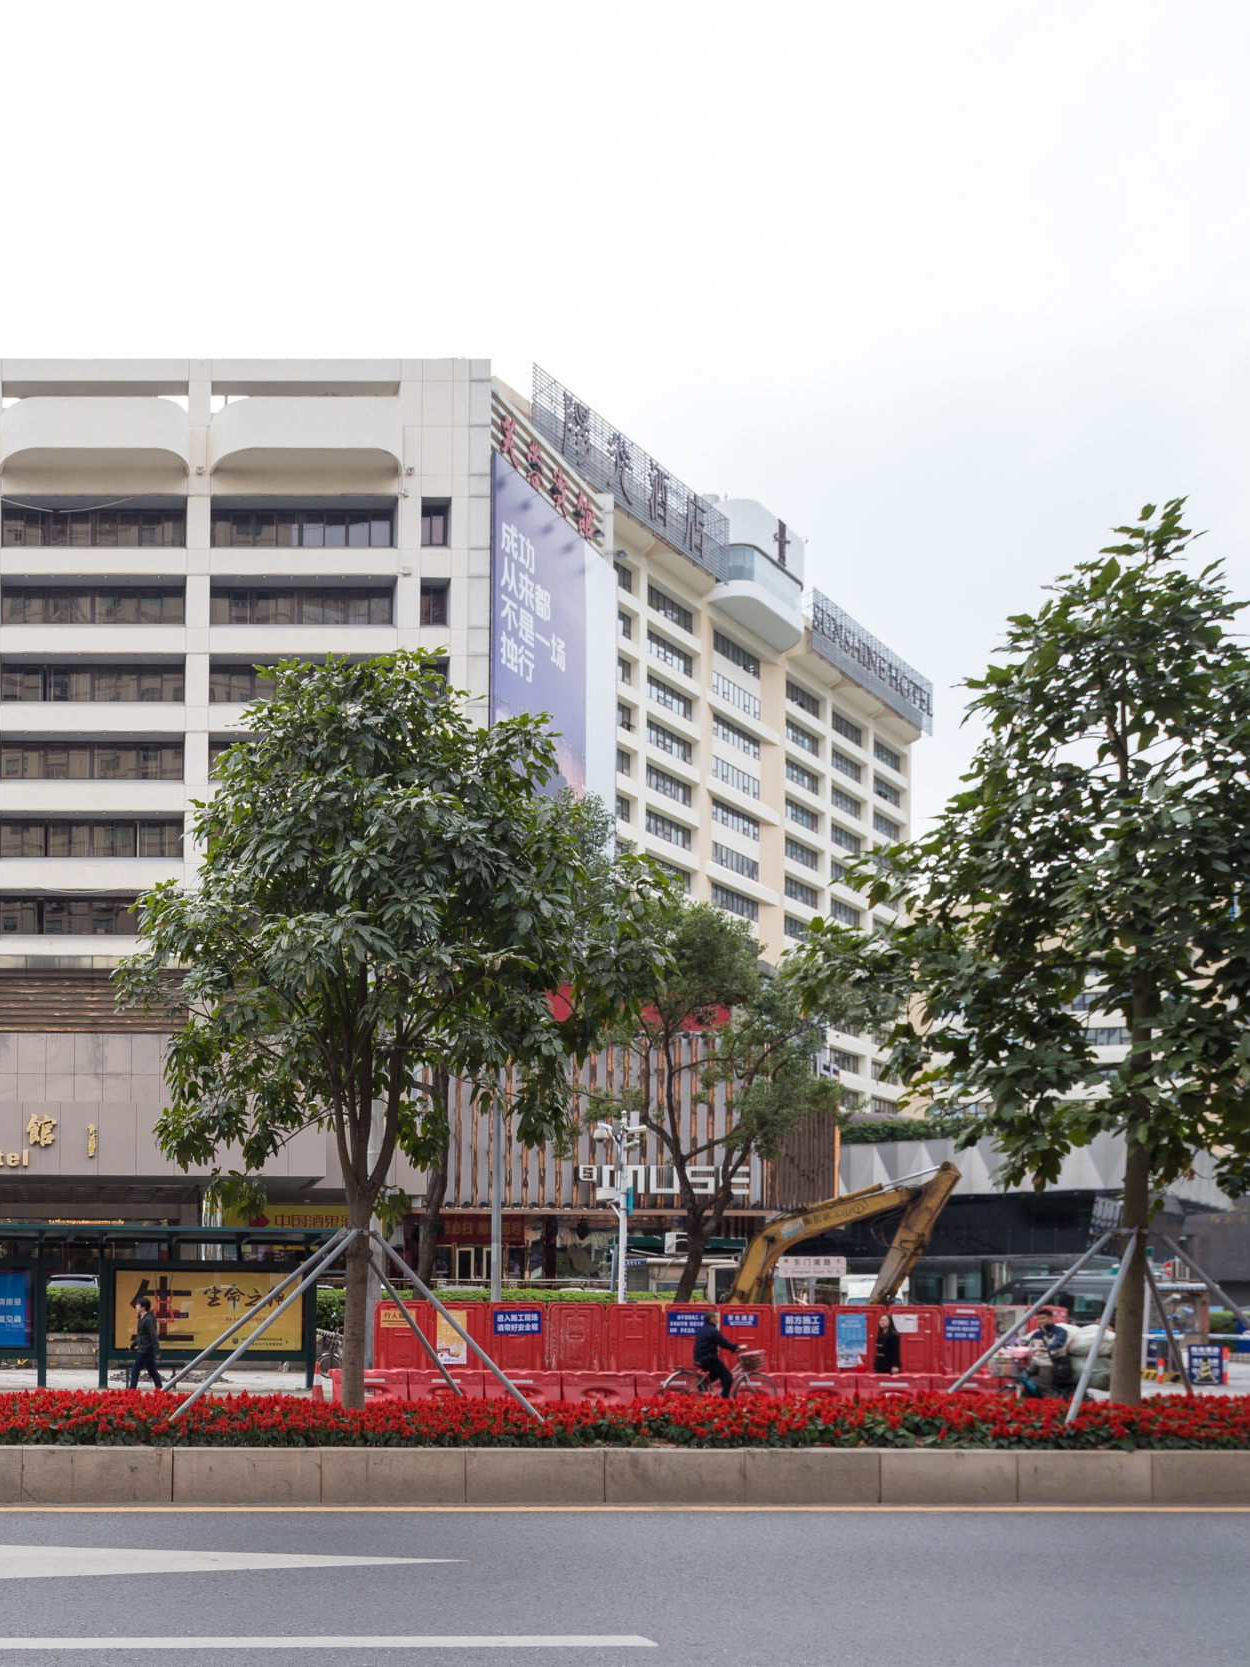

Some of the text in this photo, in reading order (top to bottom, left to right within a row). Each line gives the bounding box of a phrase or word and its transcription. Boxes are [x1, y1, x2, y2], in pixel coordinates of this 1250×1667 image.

[501, 522, 535, 575] 成功
[501, 556, 551, 622] 从来都
[501, 594, 566, 672] 不是一场
[501, 630, 535, 683] 独行
[812, 602, 933, 717] SUNSHINE HOTEL
[496, 1313, 539, 1322] 进入施工现场
[497, 1323, 539, 1332] 请带好安全帽
[784, 1315, 820, 1325] 前方施工
[784, 1325, 820, 1335] 请勿靠近
